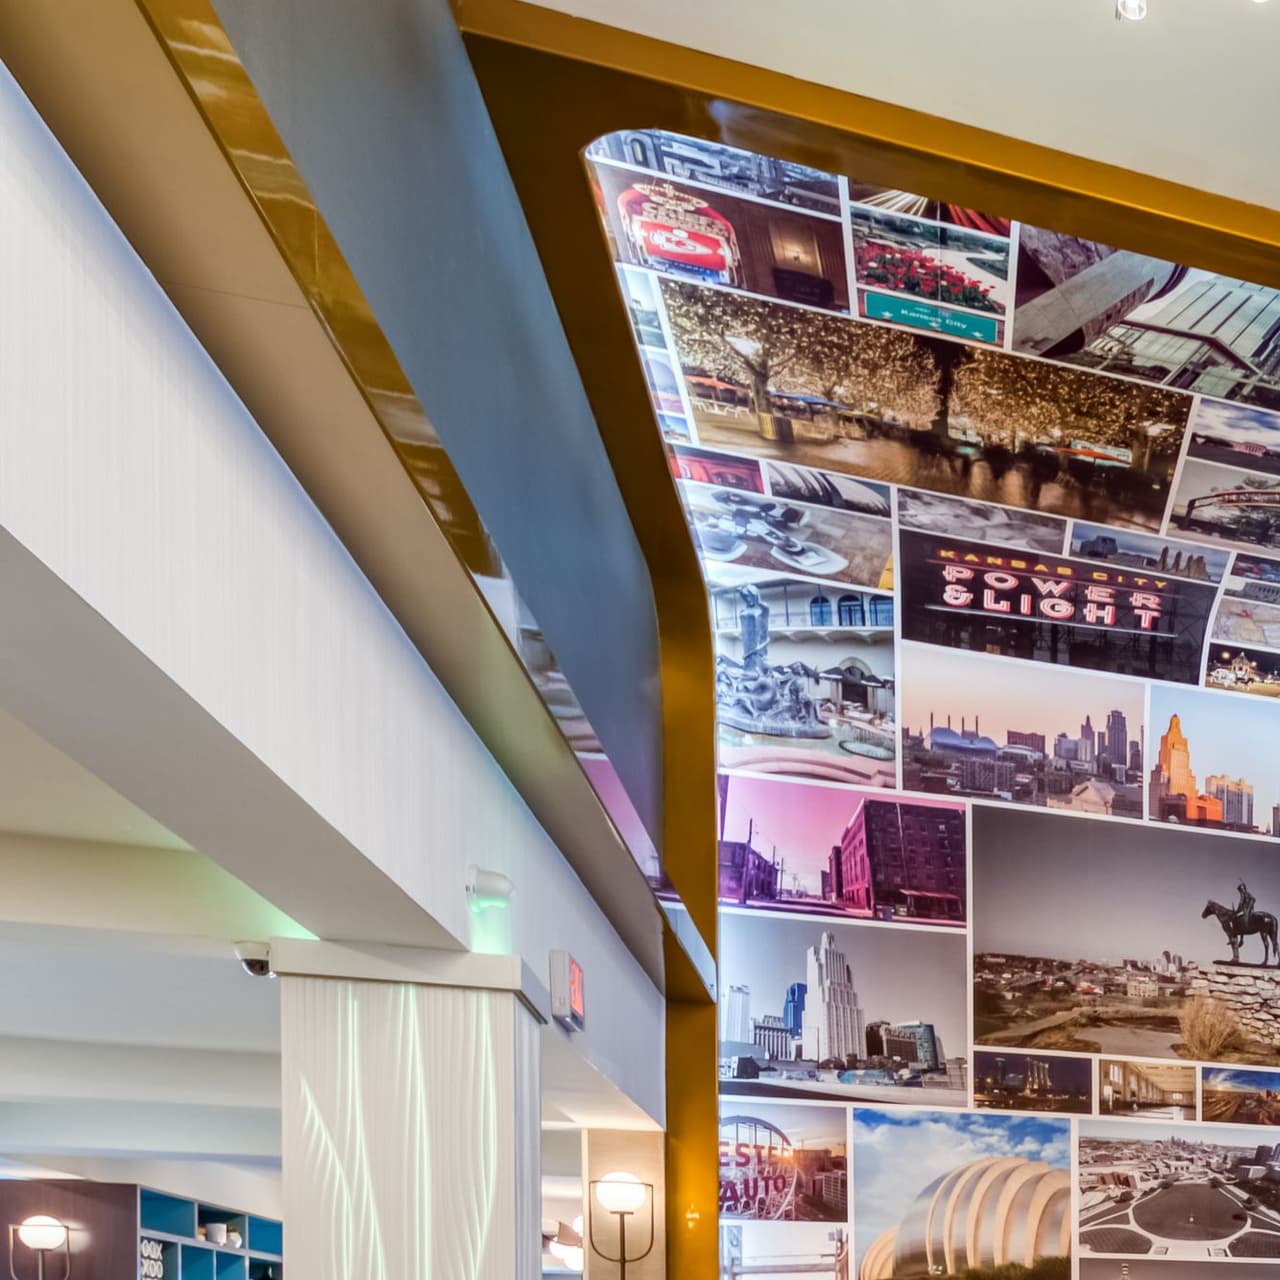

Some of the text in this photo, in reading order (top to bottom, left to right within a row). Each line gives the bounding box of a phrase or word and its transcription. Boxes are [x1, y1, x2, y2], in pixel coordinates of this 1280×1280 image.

[939, 549, 1168, 590] KANSAS CITY
[942, 565, 1162, 610] POWER
[719, 1174, 786, 1211] AUTO
